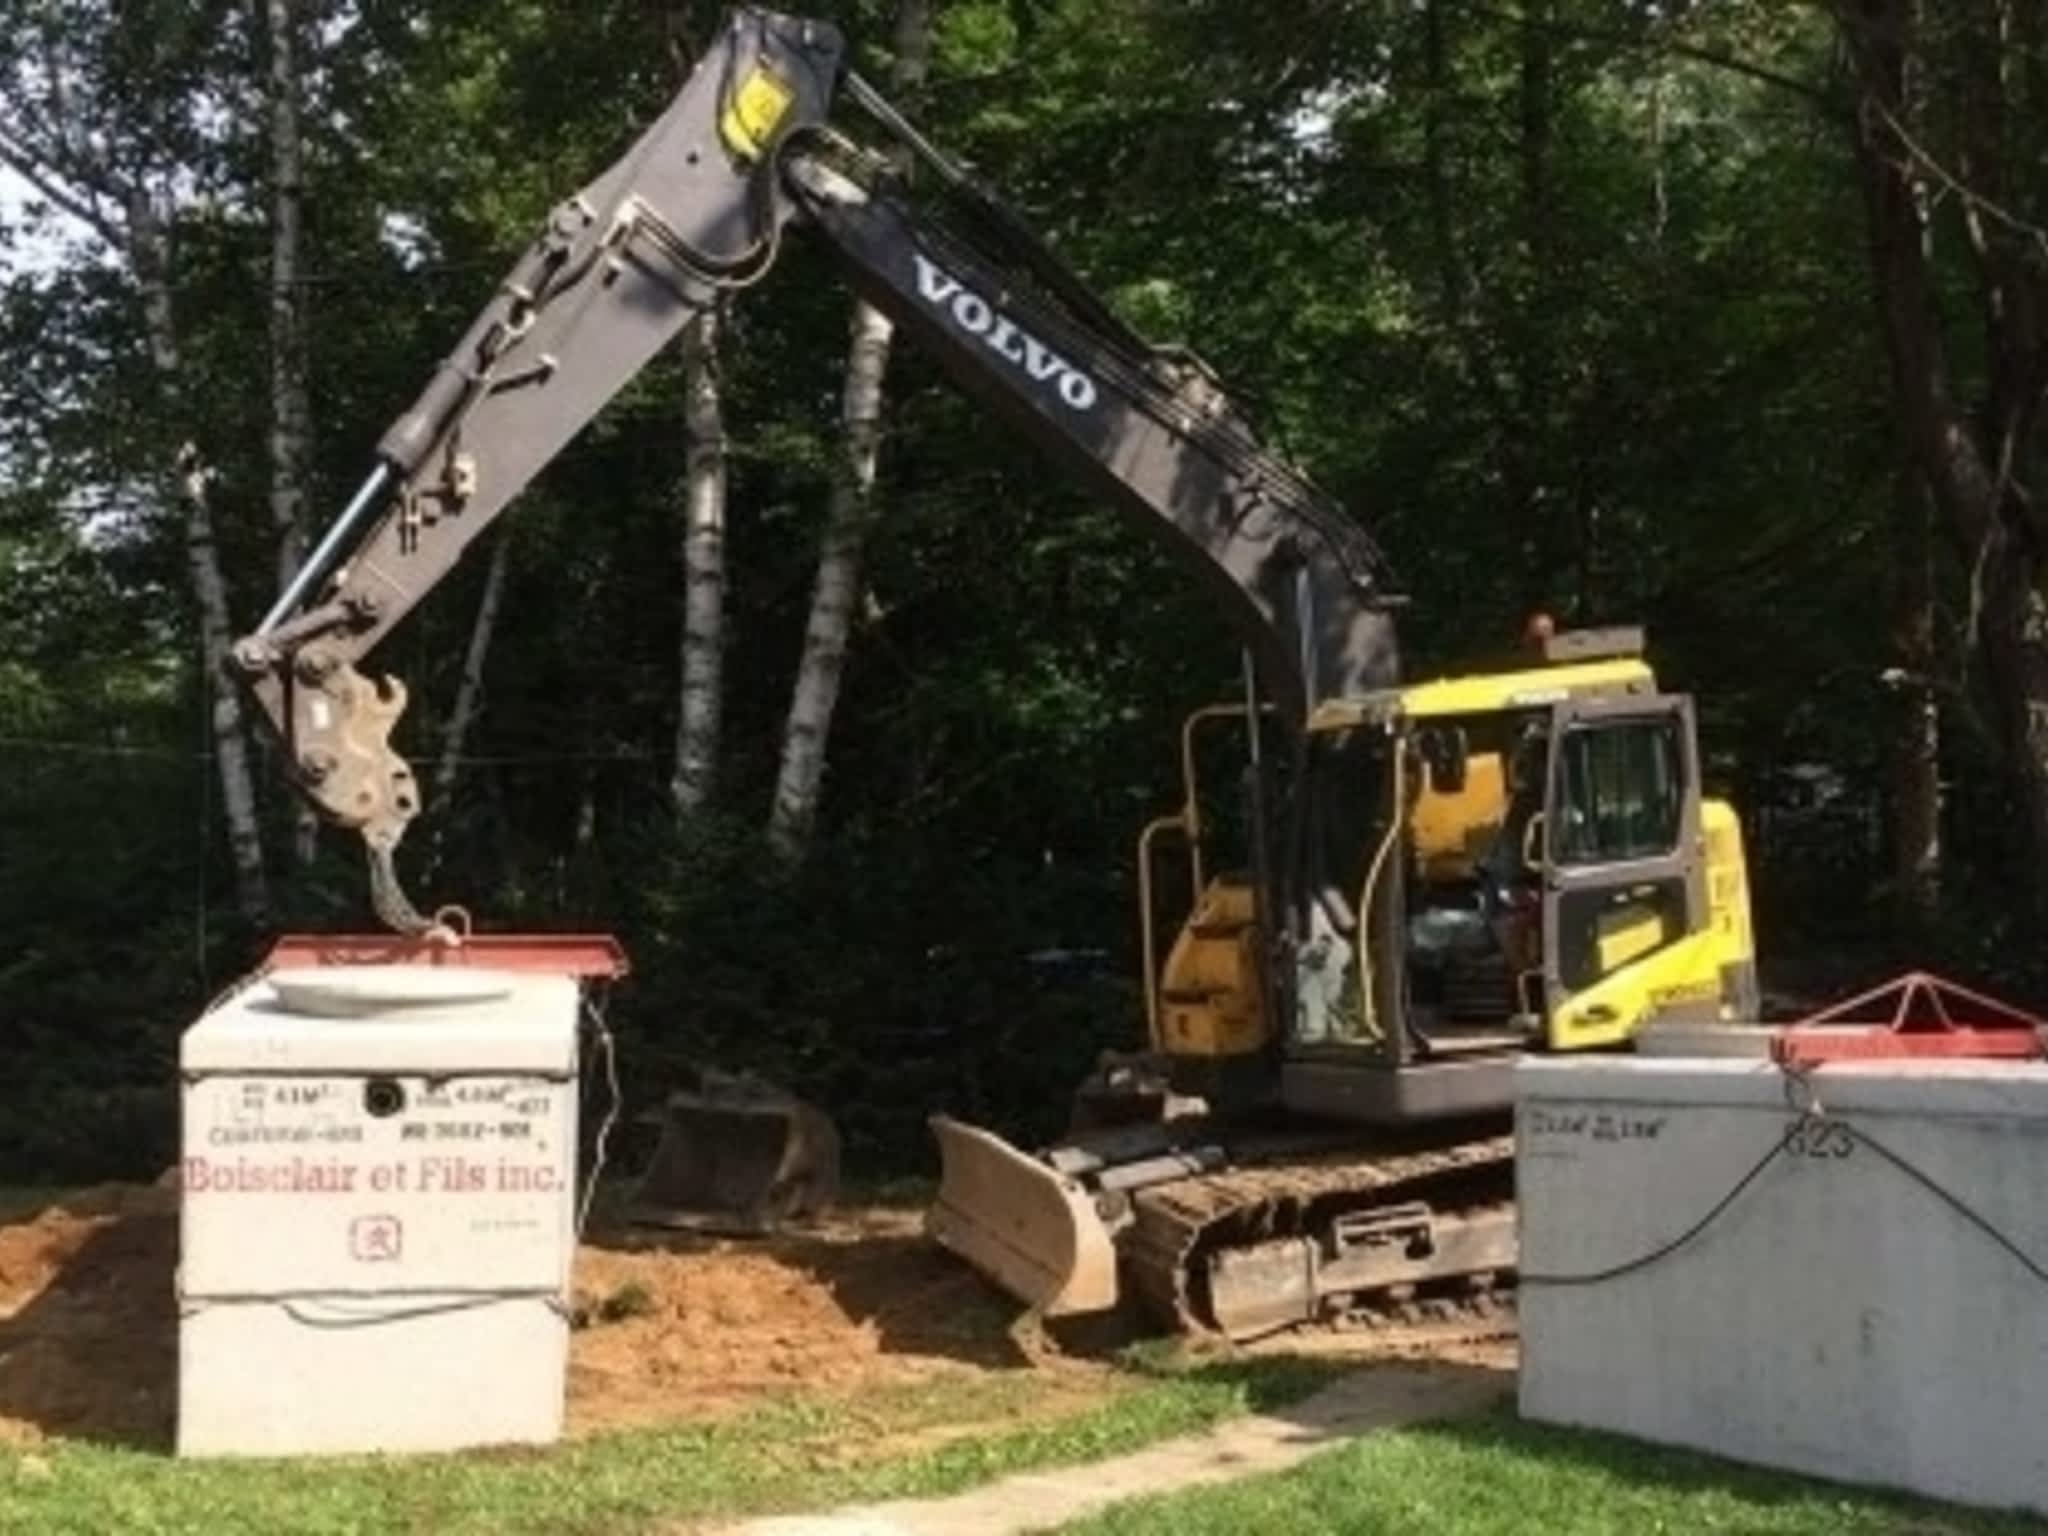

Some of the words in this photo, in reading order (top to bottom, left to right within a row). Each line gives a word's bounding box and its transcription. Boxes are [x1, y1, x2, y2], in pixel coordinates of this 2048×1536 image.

[913, 254, 1096, 410] VOLVO
[185, 1156, 357, 1193] Boisclair
[370, 1160, 406, 1192] et
[417, 1156, 486, 1192] Fils
[497, 1156, 566, 1192] inc.
